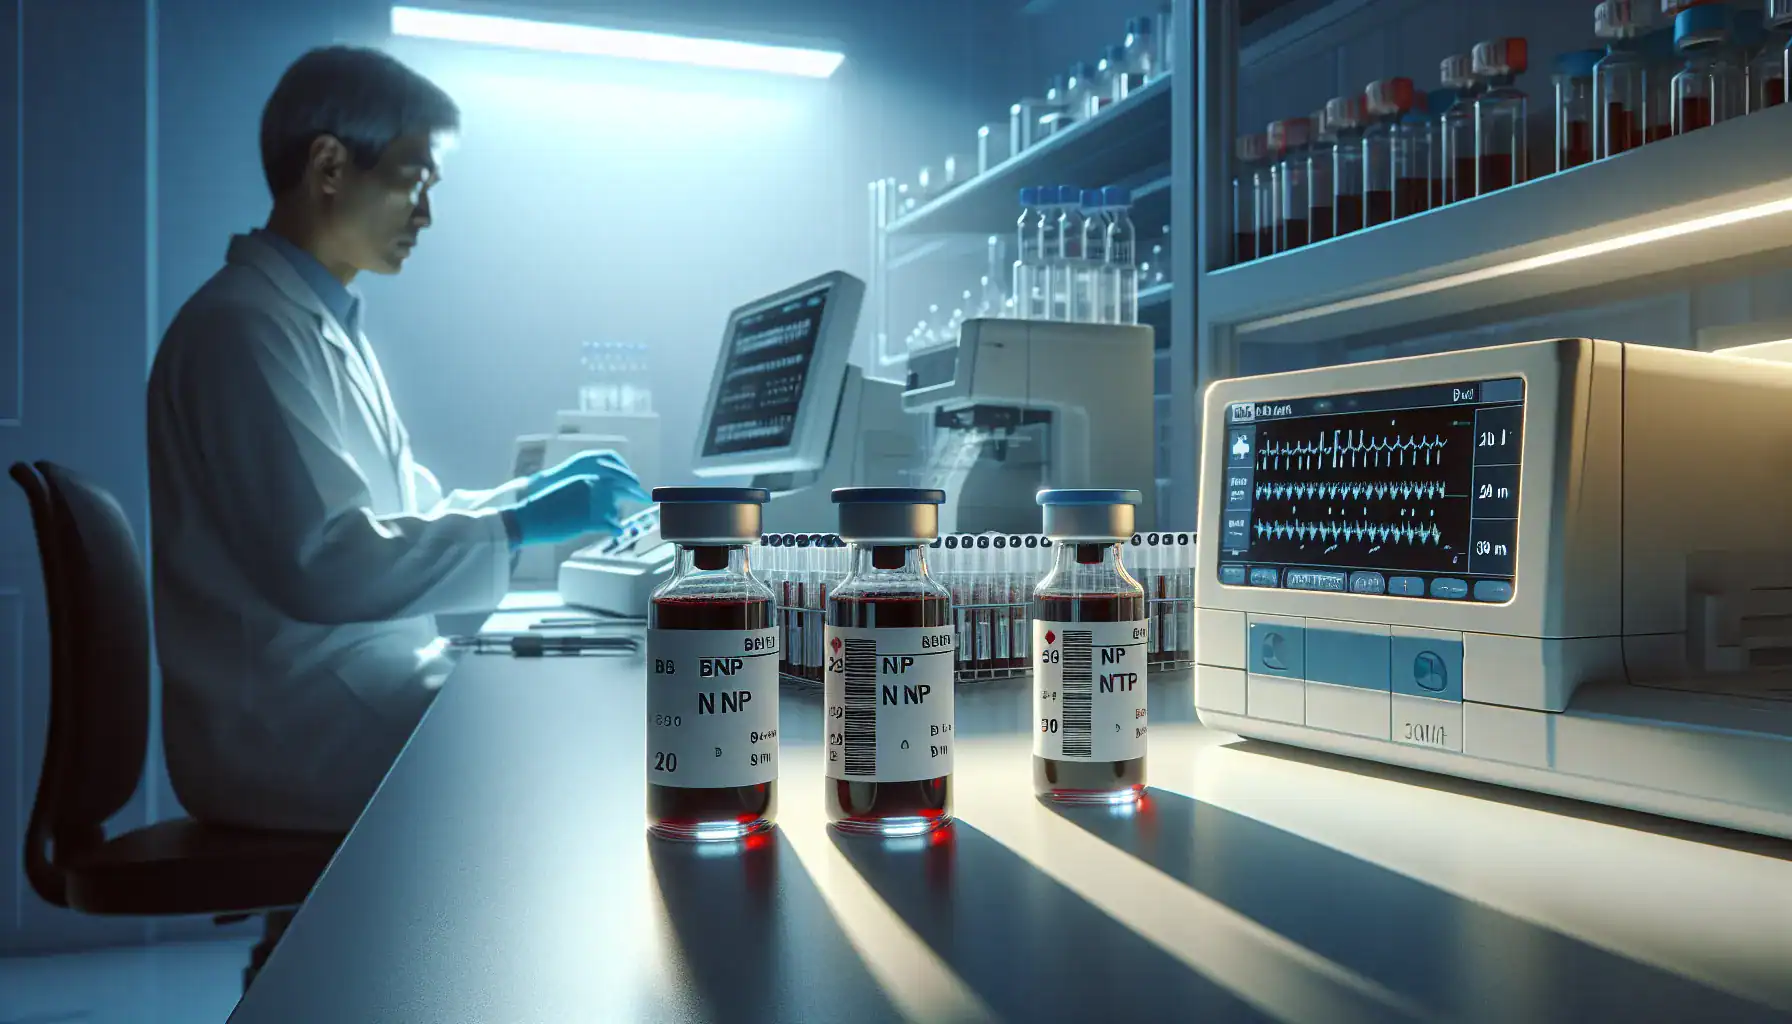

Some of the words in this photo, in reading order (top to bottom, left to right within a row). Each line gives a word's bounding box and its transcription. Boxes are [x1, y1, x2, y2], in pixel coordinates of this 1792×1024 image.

[882, 657, 914, 674] NP
[1101, 648, 1126, 665] NP
[1100, 673, 1138, 693] NTP
[654, 751, 677, 772] 20
